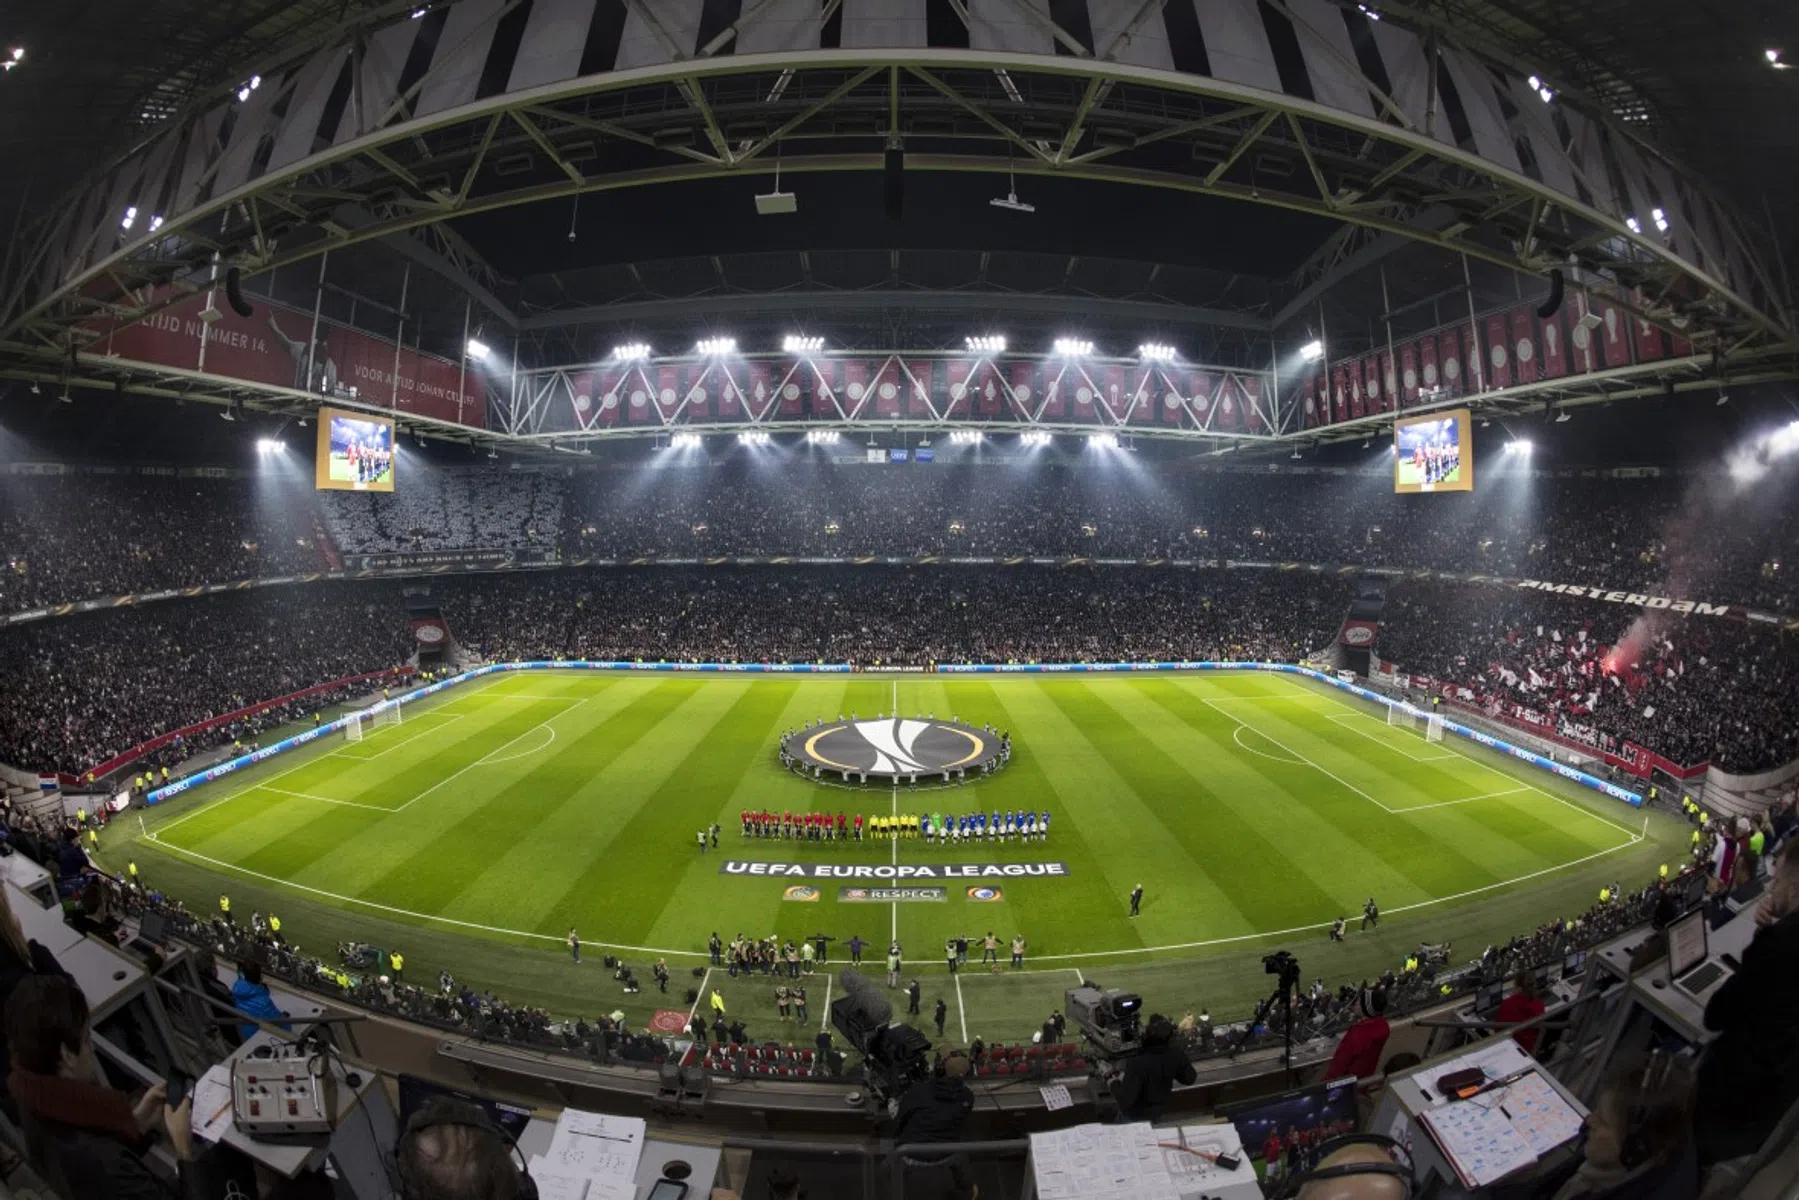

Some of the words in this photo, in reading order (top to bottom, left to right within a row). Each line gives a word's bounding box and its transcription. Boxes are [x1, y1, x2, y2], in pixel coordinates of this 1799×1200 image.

[136, 313, 180, 332] LTIJD
[184, 320, 249, 349] NUMMER
[354, 364, 382, 382] VOOR
[385, 373, 416, 390] ATIJD
[416, 382, 443, 398] JOHAN
[259, 745, 280, 759] RESPECT
[1516, 748, 1537, 764] RESPECT
[213, 762, 237, 777] RESPECT
[1558, 764, 1582, 782] RESPECT
[165, 781, 190, 797] RESPECT
[1605, 784, 1632, 803] RESPECT
[725, 861, 805, 875] UEFA
[814, 865, 936, 878] EUROPA
[945, 862, 1065, 877] LEAGUE
[871, 889, 941, 899] RESPECT
